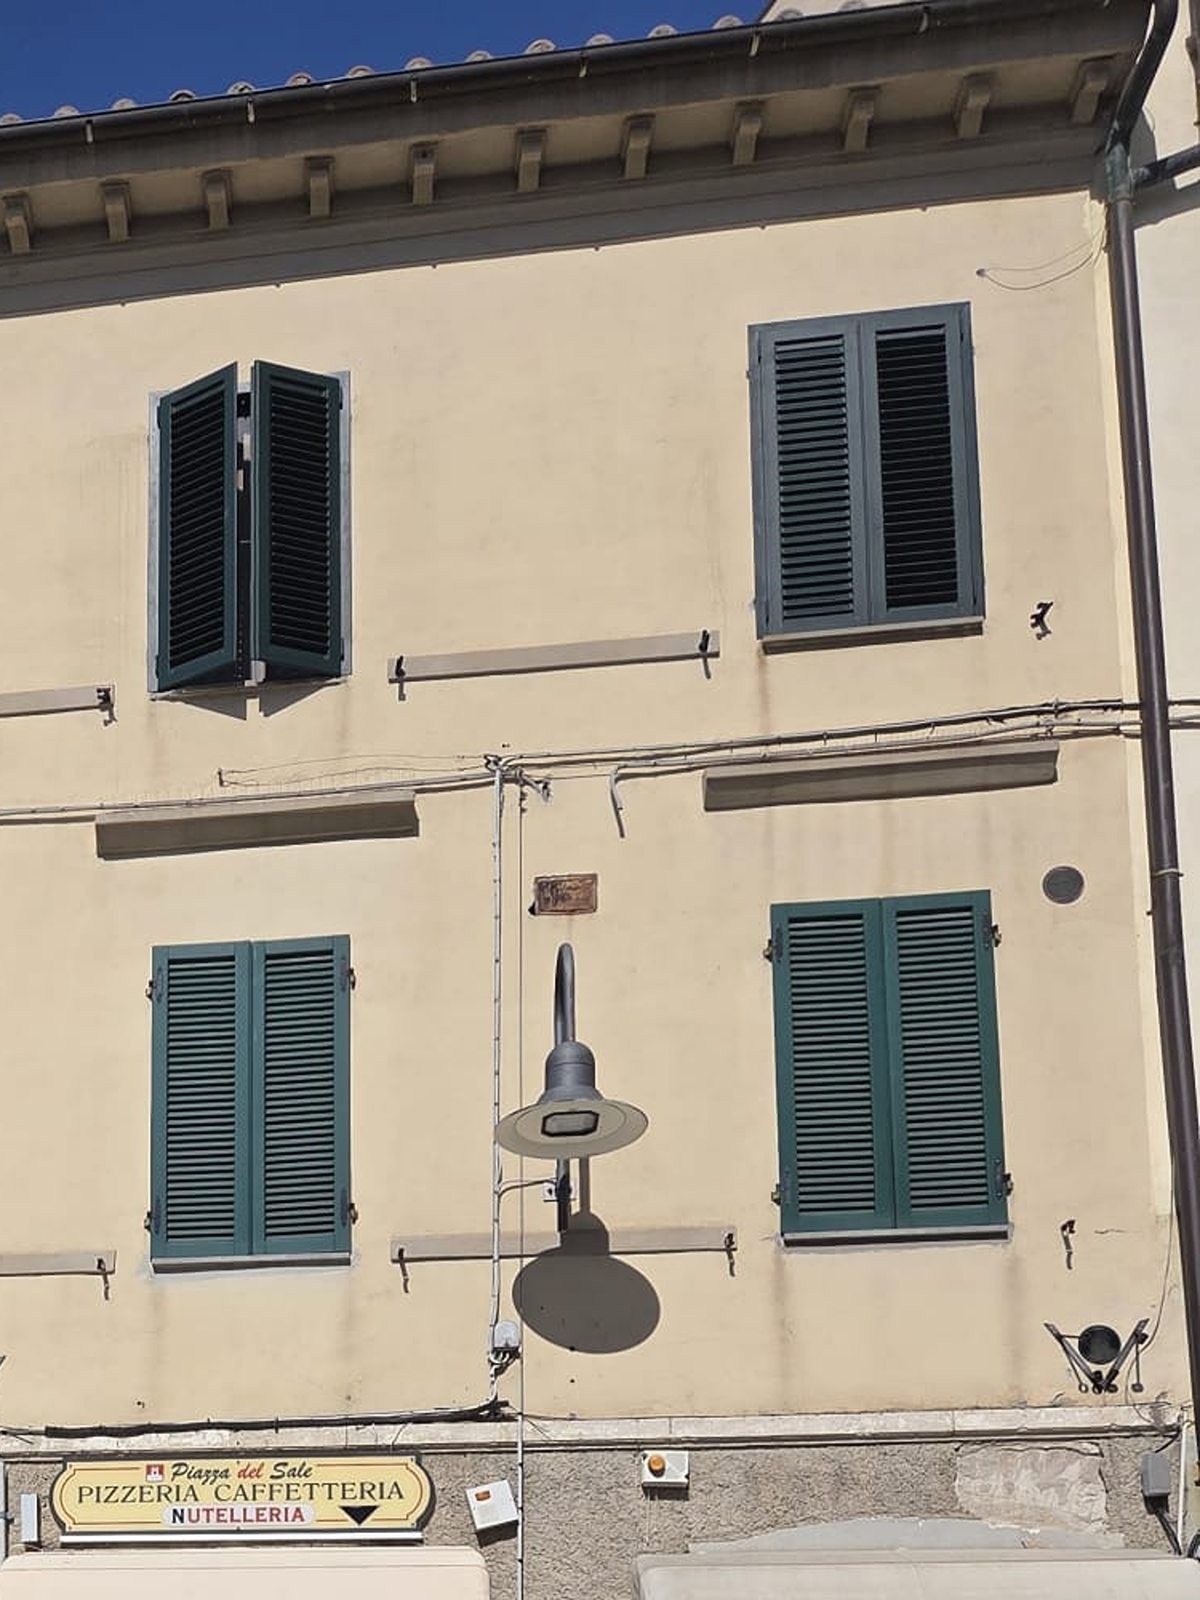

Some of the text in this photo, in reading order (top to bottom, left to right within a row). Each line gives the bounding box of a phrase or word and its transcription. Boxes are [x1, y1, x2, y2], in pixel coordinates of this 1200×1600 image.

[171, 1461, 313, 1485] Piazza del Sale
[77, 1480, 405, 1504] PIZZERIA CAFFETTERIA
[171, 1506, 305, 1525] NUTELLERIA
